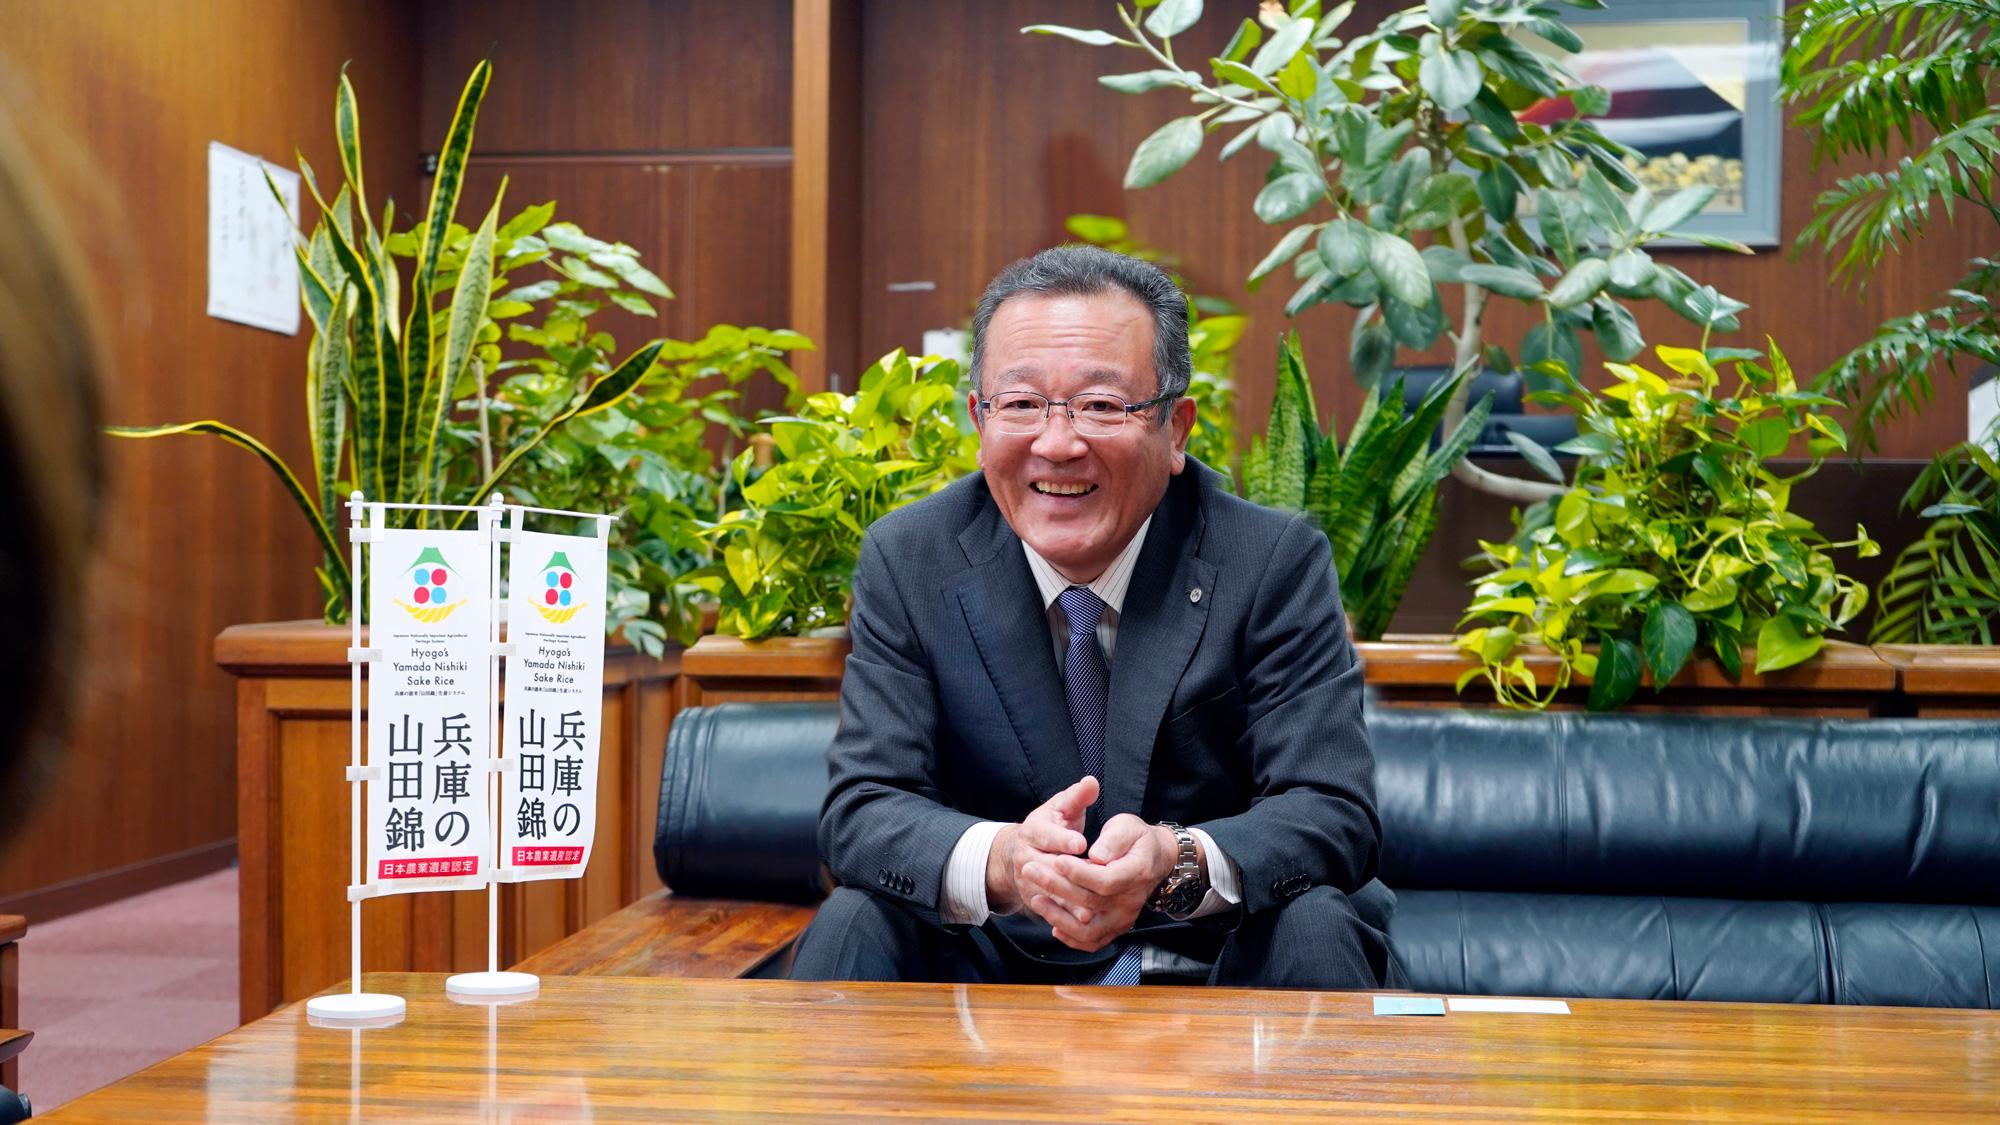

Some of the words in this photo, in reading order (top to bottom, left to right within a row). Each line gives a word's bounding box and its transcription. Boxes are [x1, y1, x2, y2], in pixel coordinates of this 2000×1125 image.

[411, 648, 449, 660] Hyogo's
[538, 646, 571, 658] Hyogo's
[393, 661, 431, 672] Yamada
[434, 661, 468, 671] Nishiki
[523, 658, 555, 669] Yamada
[557, 660, 585, 671] Nishiki
[407, 675, 431, 686] Sake
[434, 675, 455, 686] Rice
[534, 672, 554, 683] Sake
[556, 673, 574, 684] Rice
[432, 712, 473, 847] 兵庫の
[517, 708, 547, 841] 山田錦
[551, 710, 586, 837] 兵庫の
[385, 714, 425, 852] 山田錦
[517, 849, 581, 862] 日本農業遺産認定
[384, 860, 474, 875] 日本農業遺産認定
